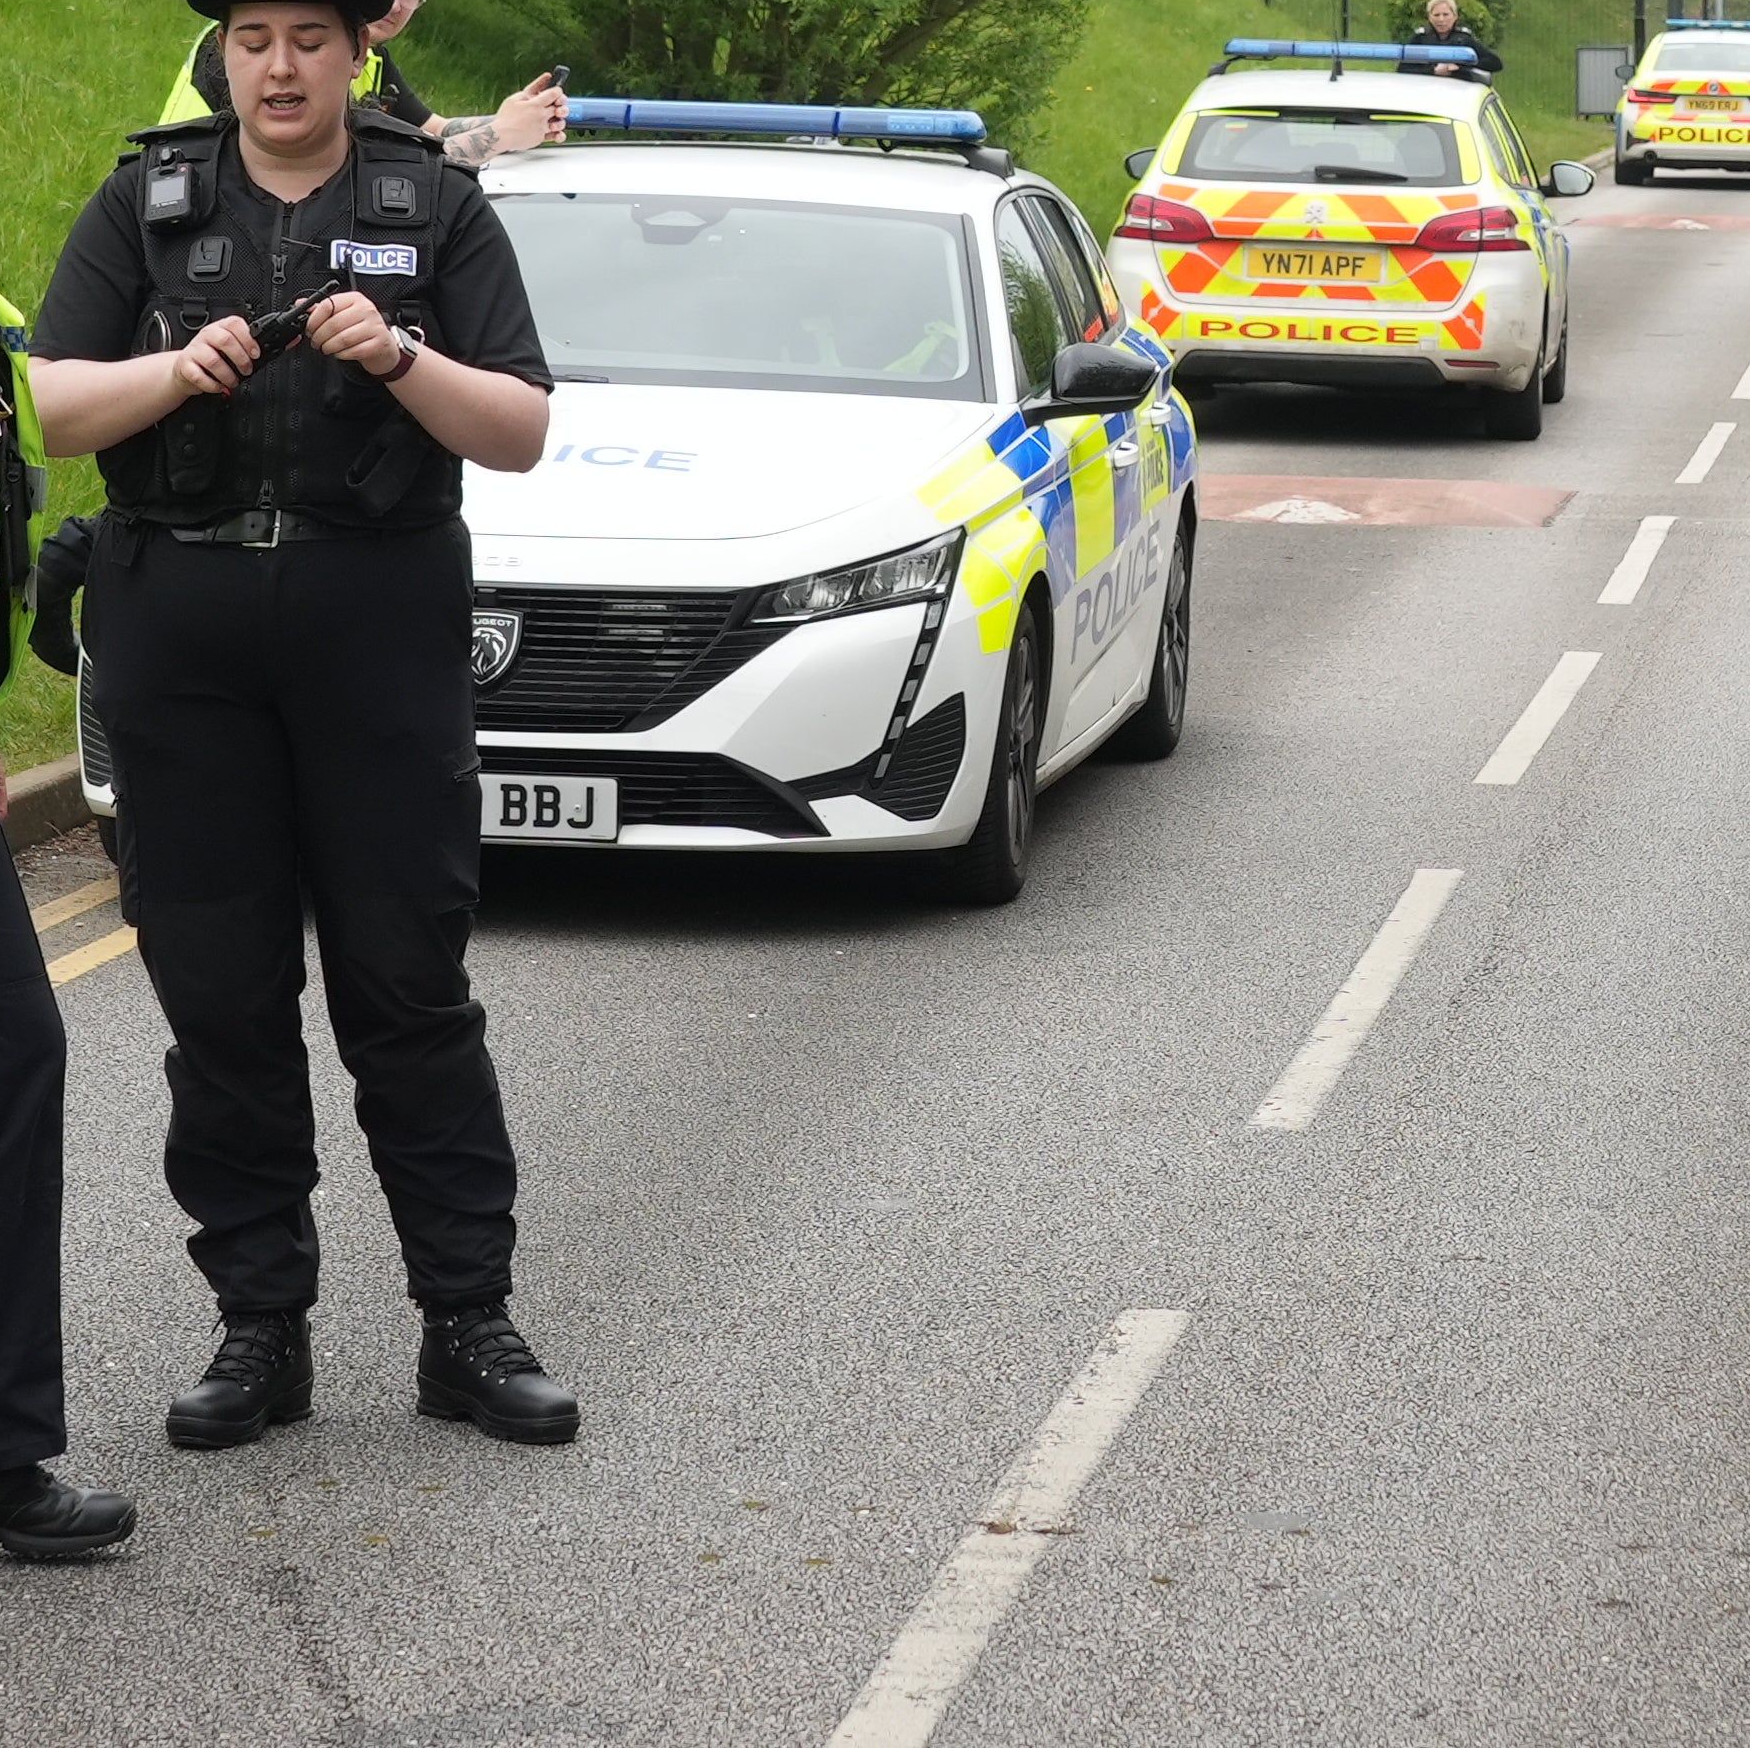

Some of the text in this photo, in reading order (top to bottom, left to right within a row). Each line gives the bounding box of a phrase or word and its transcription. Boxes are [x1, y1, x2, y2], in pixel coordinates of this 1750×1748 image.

[1262, 253, 1366, 277] YN71 APF
[1200, 320, 1419, 344] POLICE
[552, 444, 699, 473] ICE
[1070, 519, 1161, 666] POLICE
[500, 783, 594, 830] BBJ
